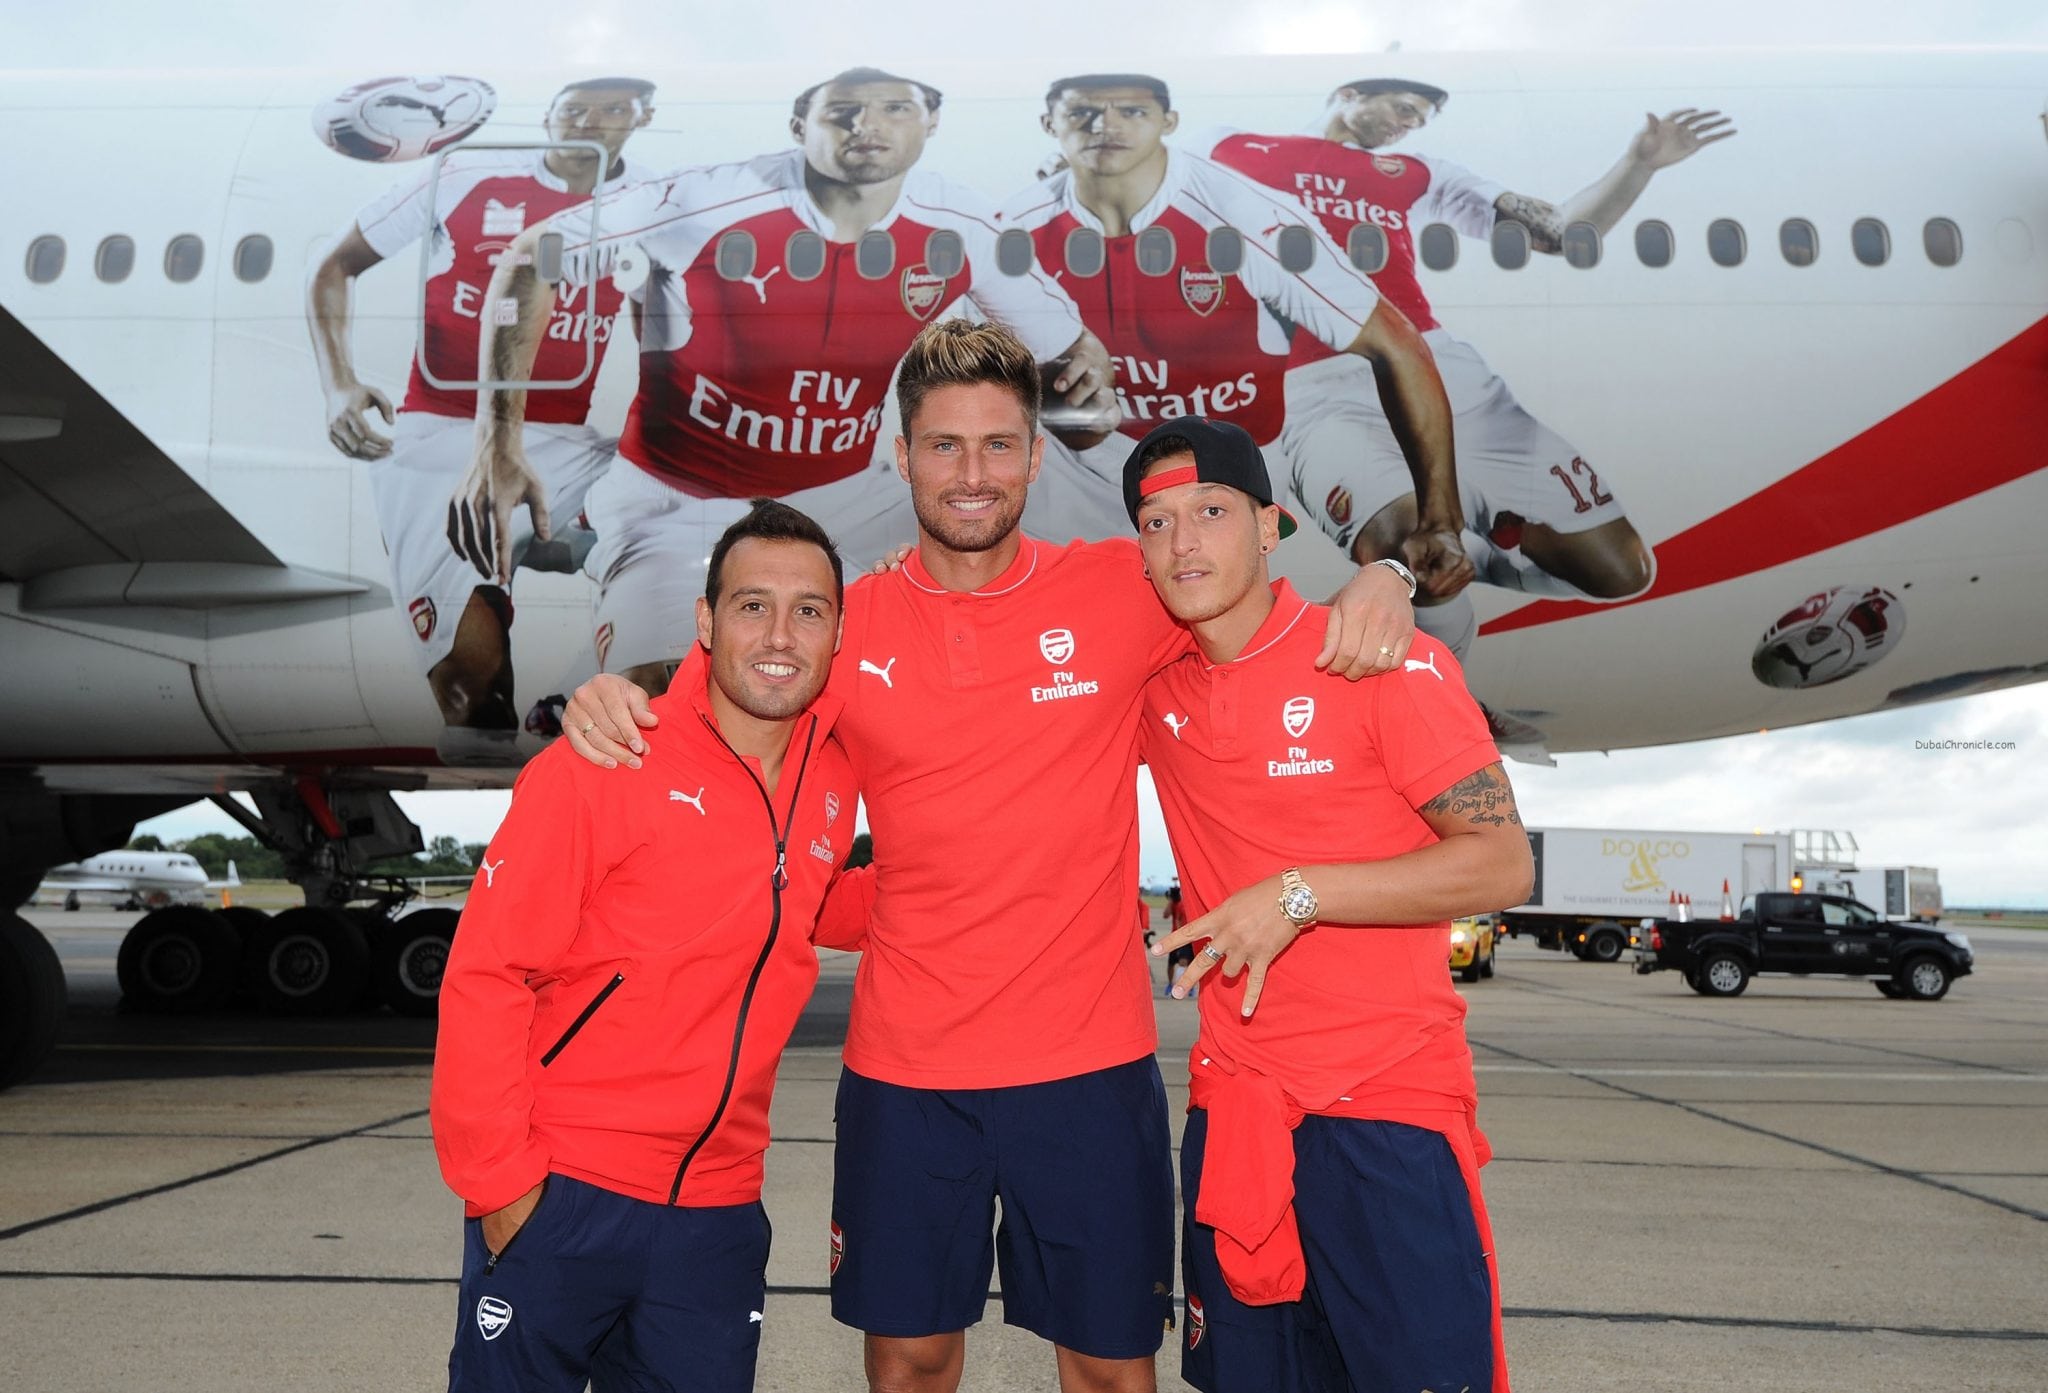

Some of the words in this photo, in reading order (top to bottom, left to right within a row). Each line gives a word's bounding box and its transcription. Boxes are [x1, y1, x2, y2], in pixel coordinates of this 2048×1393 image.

[1295, 173, 1346, 195] Fly
[1303, 189, 1404, 230] irates
[789, 370, 861, 410] Fly
[1115, 371, 1258, 420] irates
[1550, 455, 1614, 514] 12
[1052, 671, 1074, 684] Fly
[1030, 680, 1099, 703] Emirates
[1287, 746, 1308, 760] Fly
[1267, 758, 1335, 777] Emirates
